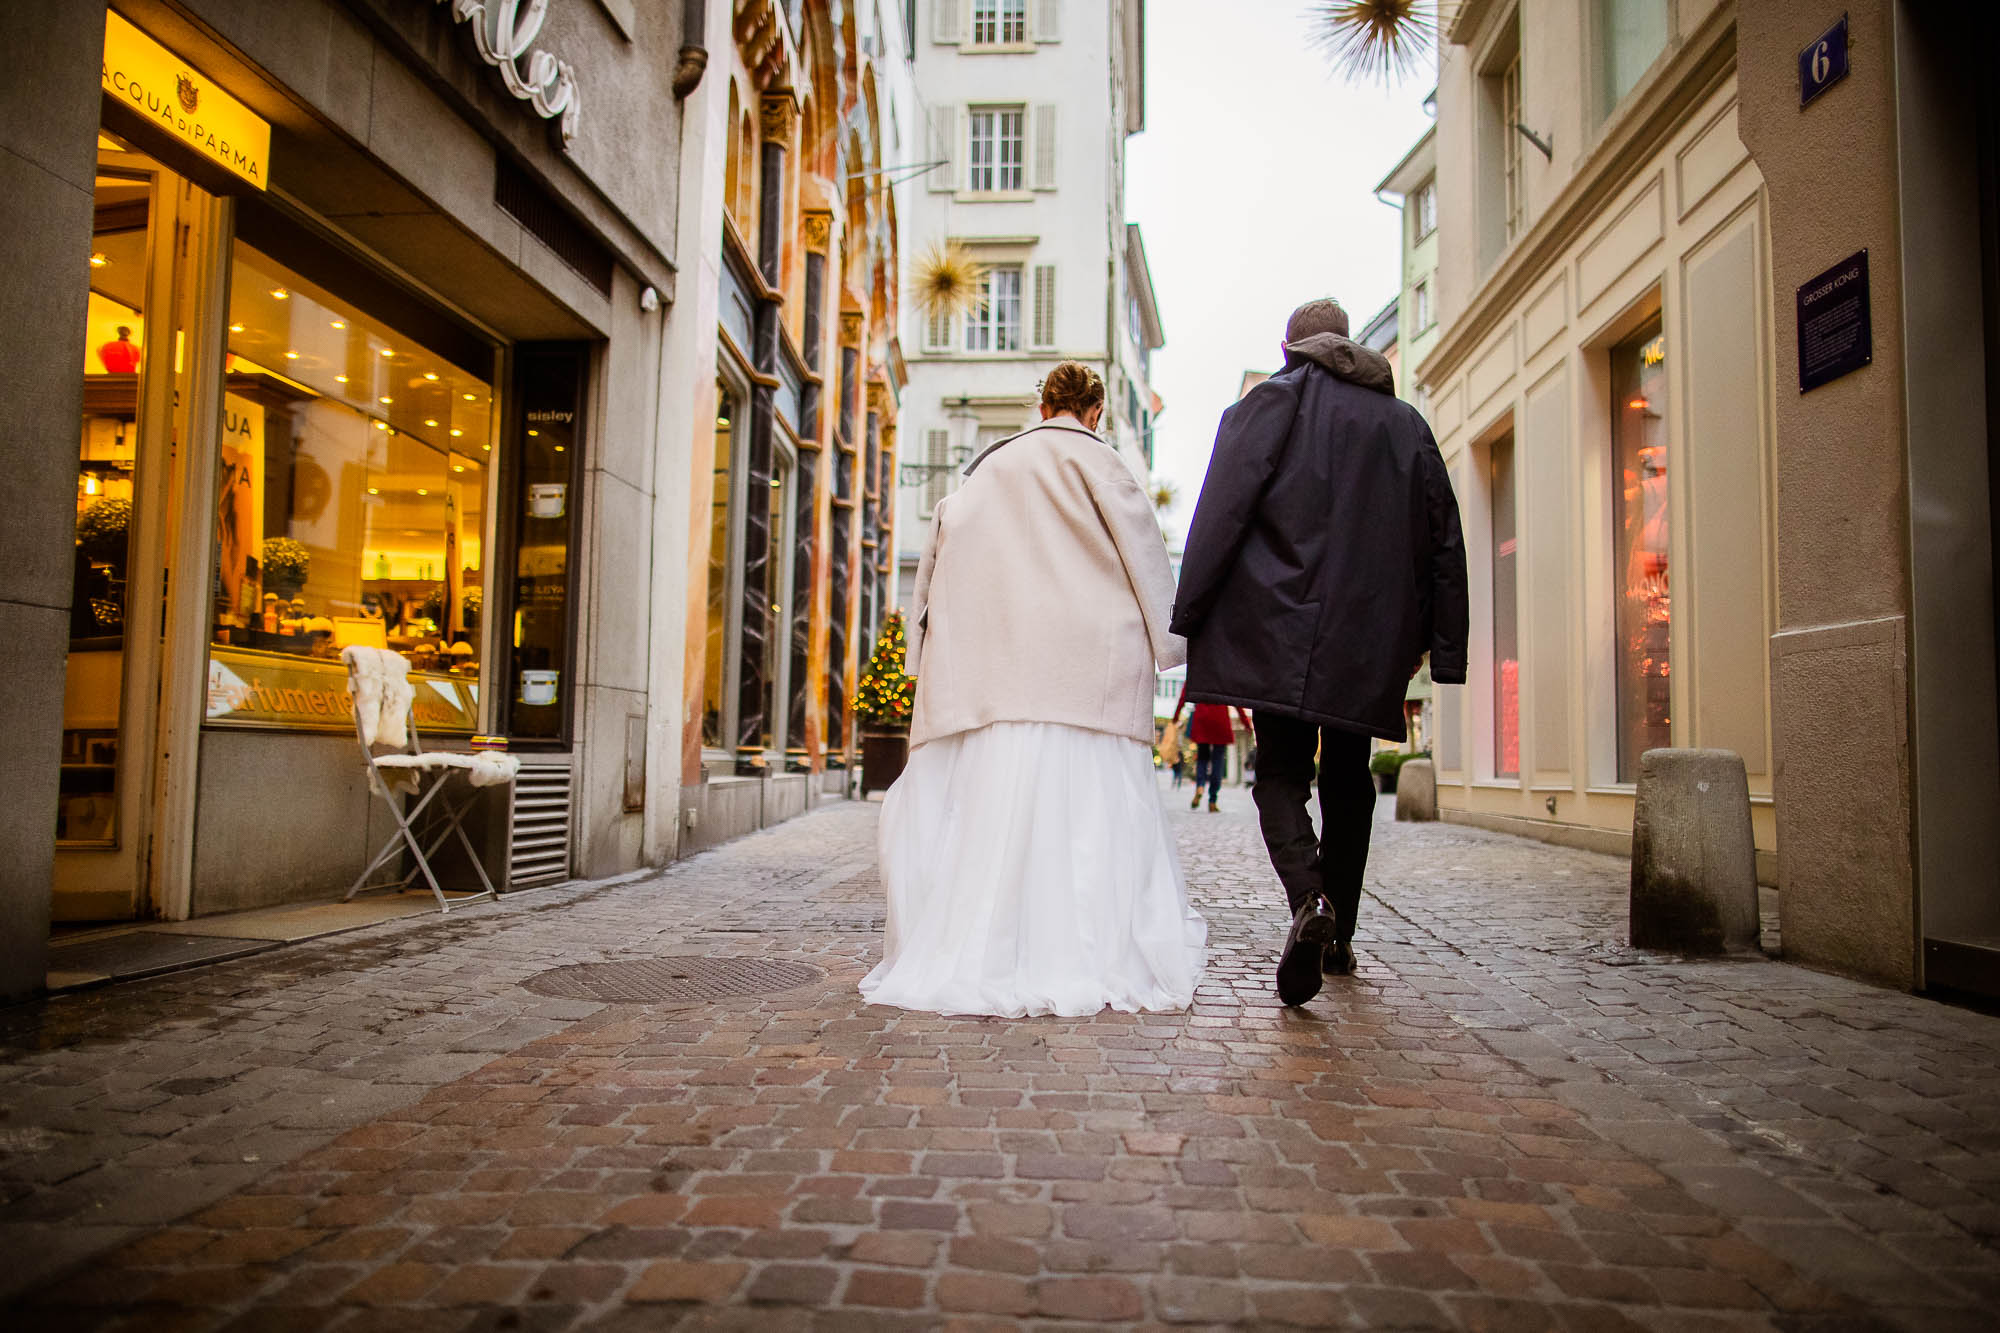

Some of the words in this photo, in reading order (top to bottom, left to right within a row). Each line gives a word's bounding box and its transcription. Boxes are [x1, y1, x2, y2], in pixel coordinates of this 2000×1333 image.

[1812, 41, 1830, 83] 6
[102, 63, 173, 124] ACQUA
[178, 118, 192, 135] DI
[194, 124, 259, 179] PARMA
[1803, 282, 1833, 306] GROSSER
[528, 407, 573, 424] sisley
